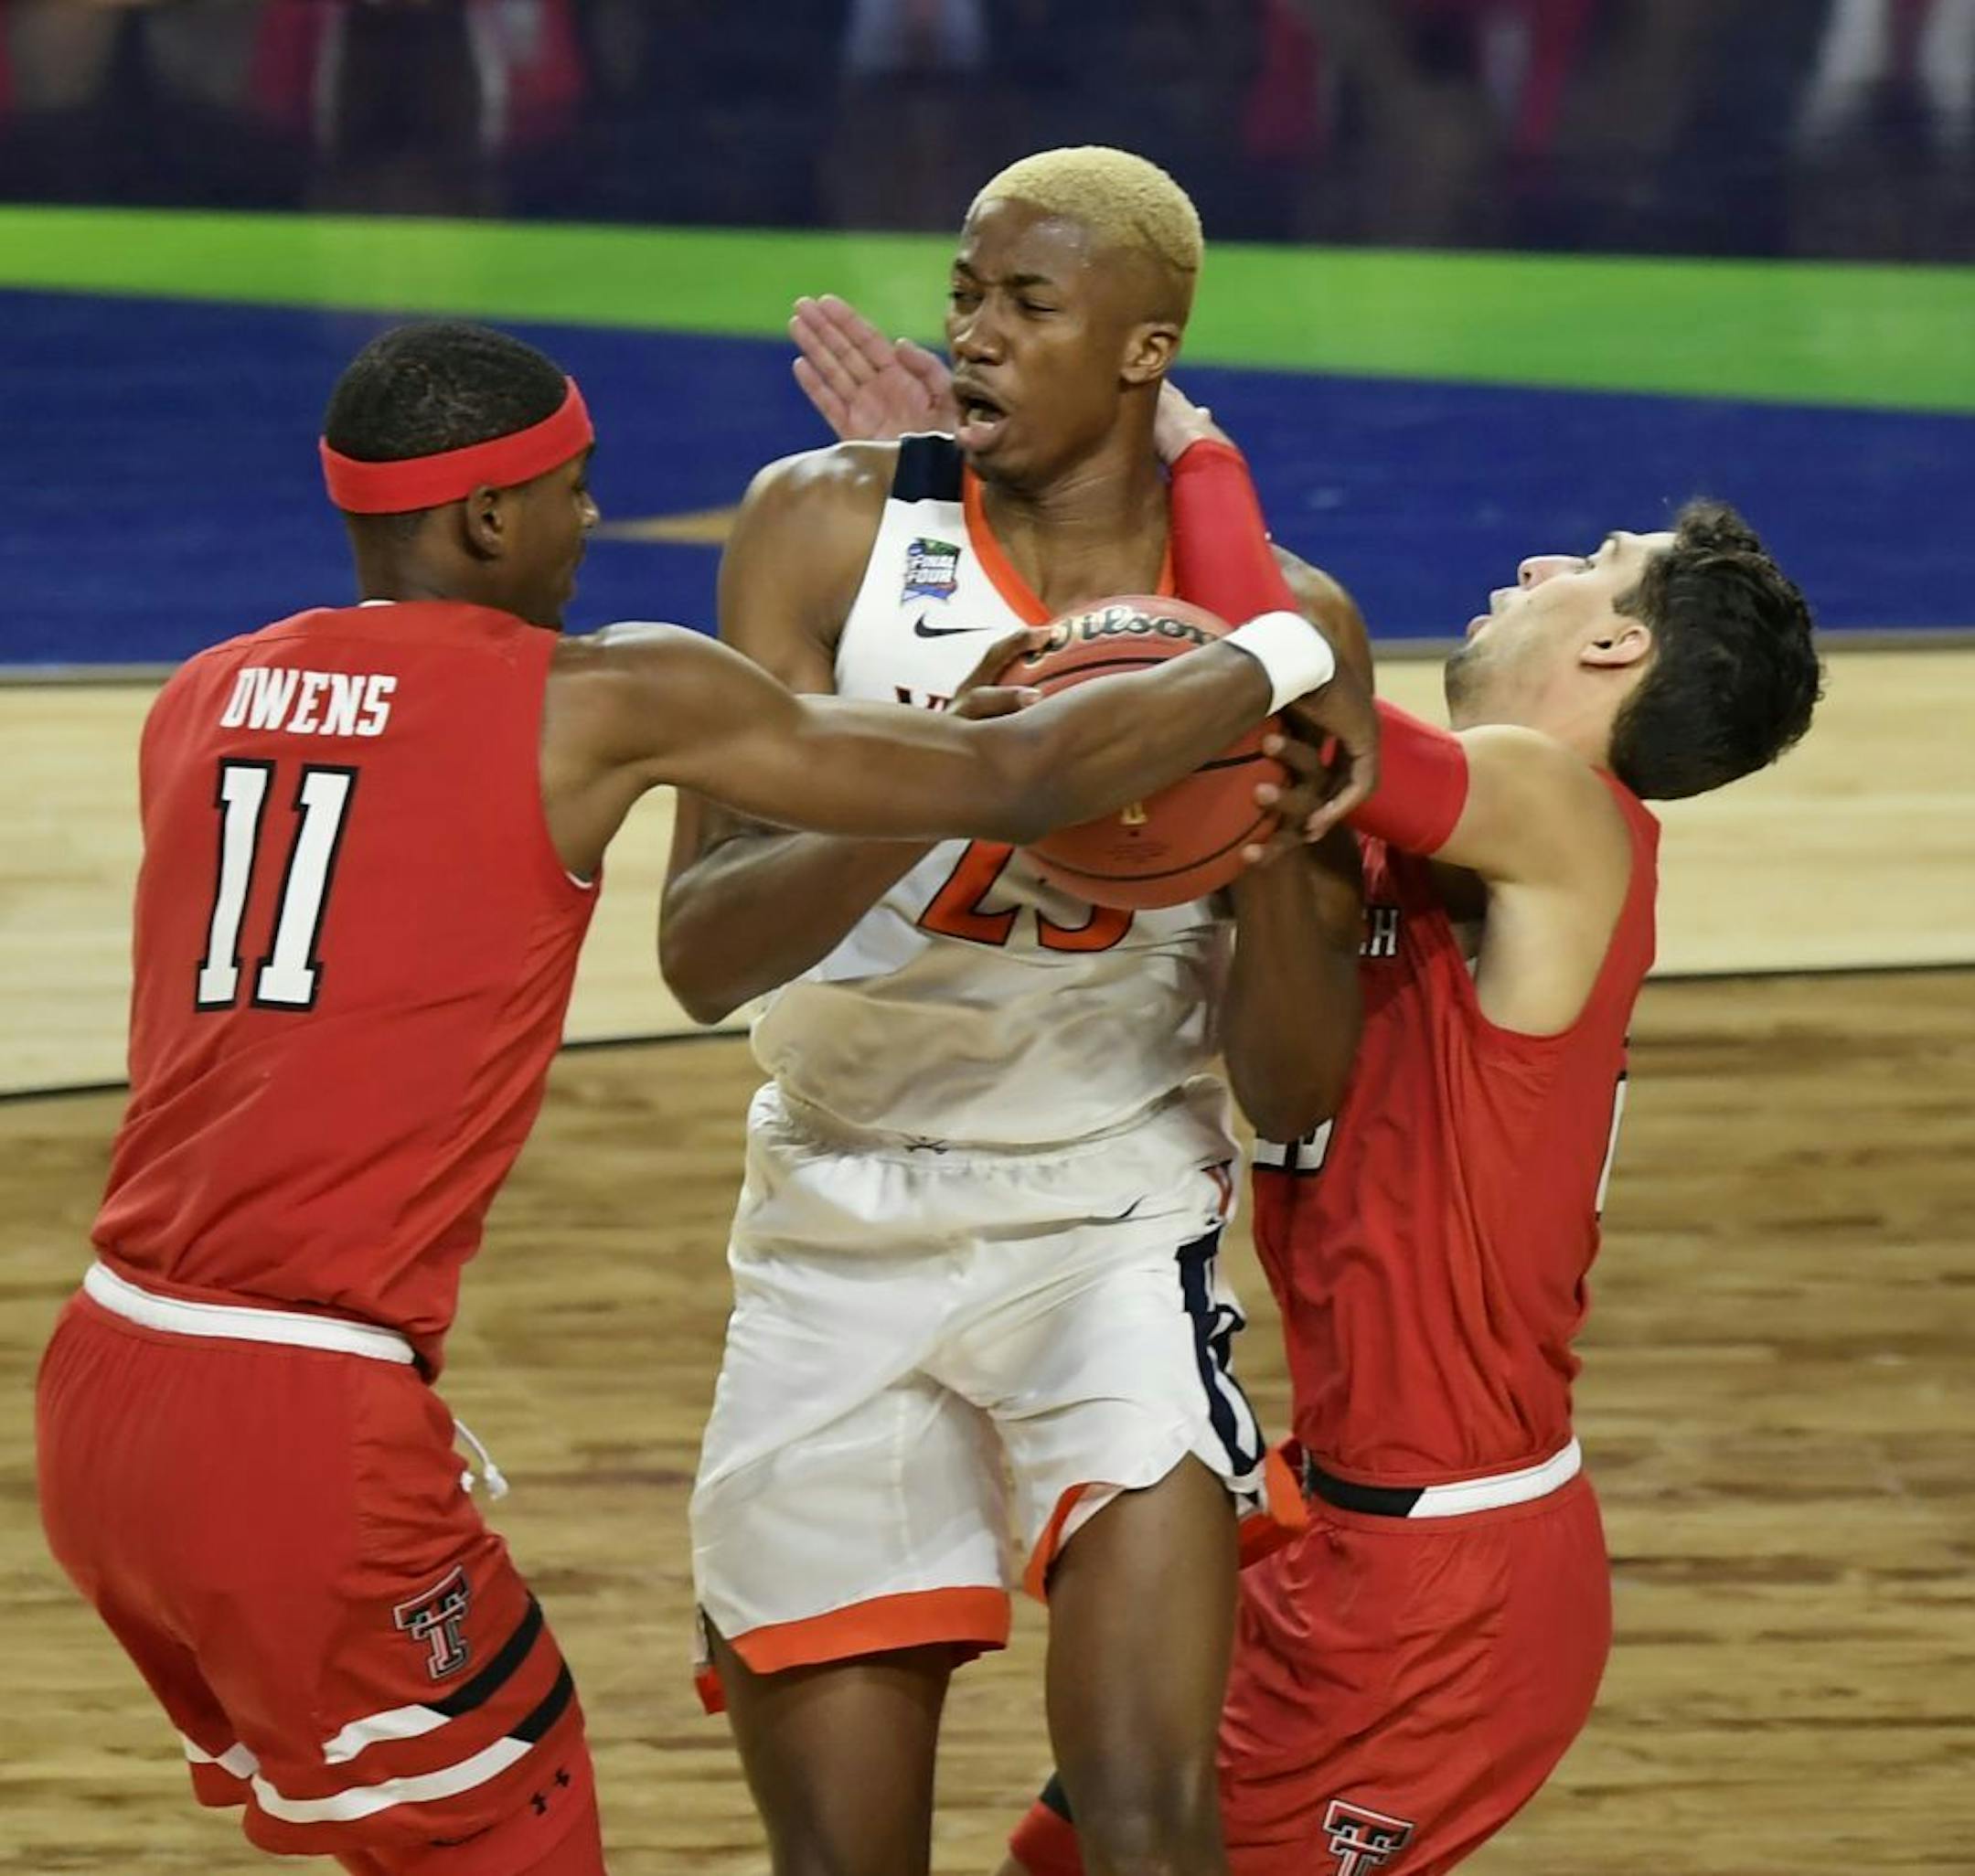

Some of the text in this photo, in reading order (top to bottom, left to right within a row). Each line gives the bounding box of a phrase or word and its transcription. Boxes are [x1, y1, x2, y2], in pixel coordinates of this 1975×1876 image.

[904, 568, 954, 584] FOUR
[219, 666, 398, 737] OWENS
[194, 756, 359, 1014] 11
